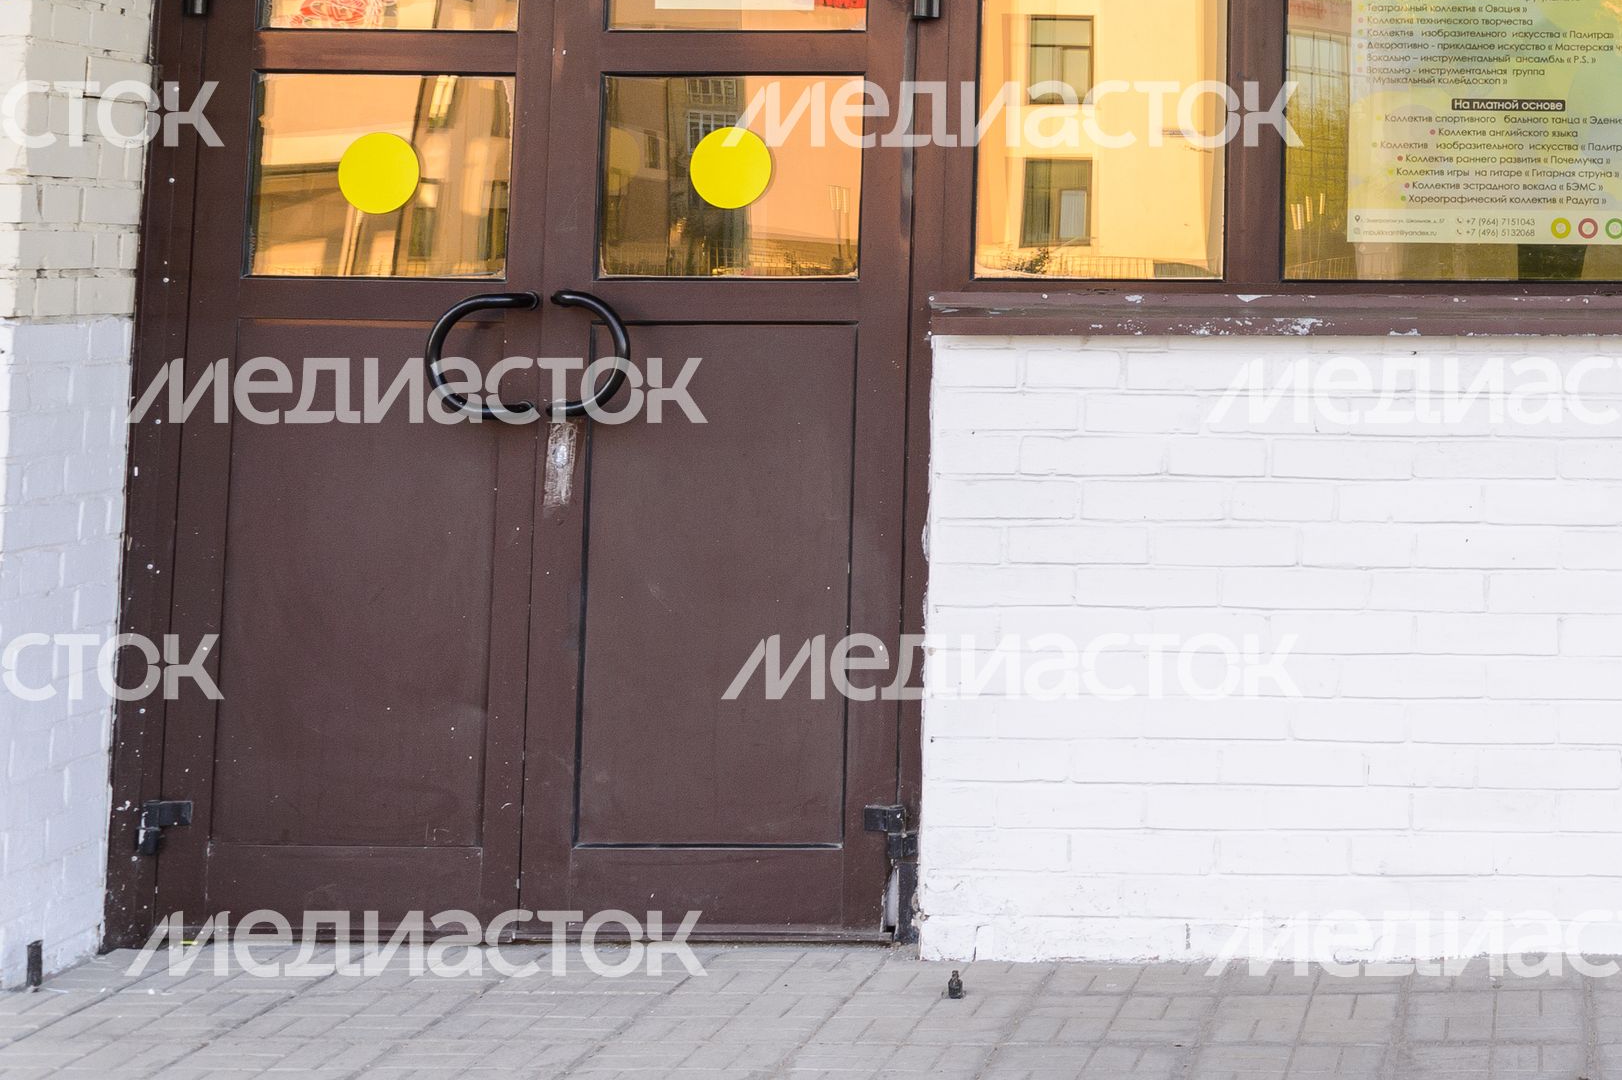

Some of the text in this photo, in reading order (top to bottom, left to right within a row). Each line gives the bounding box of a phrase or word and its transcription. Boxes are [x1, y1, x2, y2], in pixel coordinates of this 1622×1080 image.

[1368, 4, 1427, 13] Театральный
[1485, 5, 1520, 14] Овация
[1367, 17, 1413, 25] Коллектив
[1367, 29, 1413, 37] Коллектив
[1421, 29, 1506, 38] изобразительного
[1512, 31, 1560, 39] искусства
[1367, 42, 1429, 51] Декоративно
[1437, 43, 1495, 51] прикладное
[1498, 44, 1546, 52] искусство
[1555, 43, 1614, 52] Мастерская
[1420, 55, 1510, 63] инструментальный
[1516, 55, 1564, 63] ансамбль
[1573, 56, 1590, 64] P.S.
[1367, 67, 1410, 75] Вокально
[1418, 68, 1507, 76] инструментальная
[1372, 76, 1500, 85] Музыкальный калейдоскоп
[1454, 100, 1563, 110] На платной основе
[1384, 114, 1432, 123] Коллектив
[1435, 115, 1496, 124] спортивного
[1504, 115, 1548, 124] бального
[1438, 128, 1578, 138] Коллектив английского языка
[1380, 141, 1428, 149] Коллектив
[1436, 141, 1523, 150] изобразительного
[1529, 143, 1578, 151] искусства
[1405, 155, 1453, 163] Коллектив
[1550, 156, 1603, 165] Почемучка
[1396, 168, 1444, 176] Коллектив
[1447, 169, 1469, 177] игры
[1490, 170, 1522, 178] гитаре
[1531, 169, 1575, 178] Гитарная
[1578, 171, 1612, 179] струна
[1412, 181, 1596, 191] Коллектив эстрадного вокала БЭМС
[1408, 194, 1599, 206] Хореографический коллектив Радуга
[1478, 218, 1498, 227] (964)
[1502, 218, 1535, 226] 7151043
[1478, 229, 1498, 238] (496)
[1502, 229, 1535, 237] 5132068
